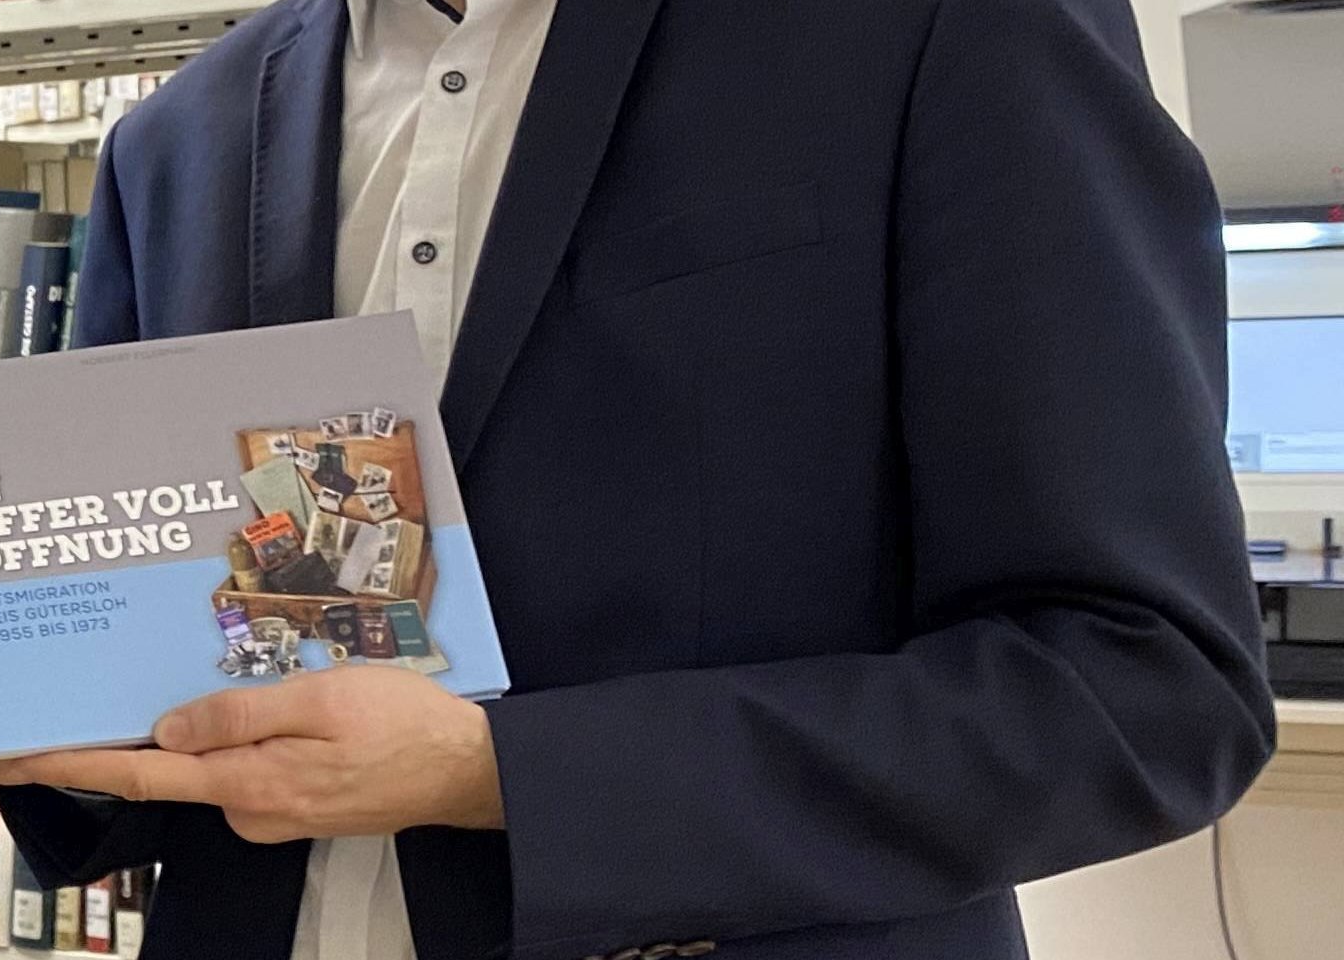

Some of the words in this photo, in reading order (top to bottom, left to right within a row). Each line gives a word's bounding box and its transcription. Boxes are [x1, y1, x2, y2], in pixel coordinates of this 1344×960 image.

[23, 284, 37, 337] GESTAPO
[113, 480, 239, 520] VOLL
[25, 596, 128, 622] GÜTERSLOH
[40, 621, 67, 637] BIS
[72, 617, 111, 633] 1973
